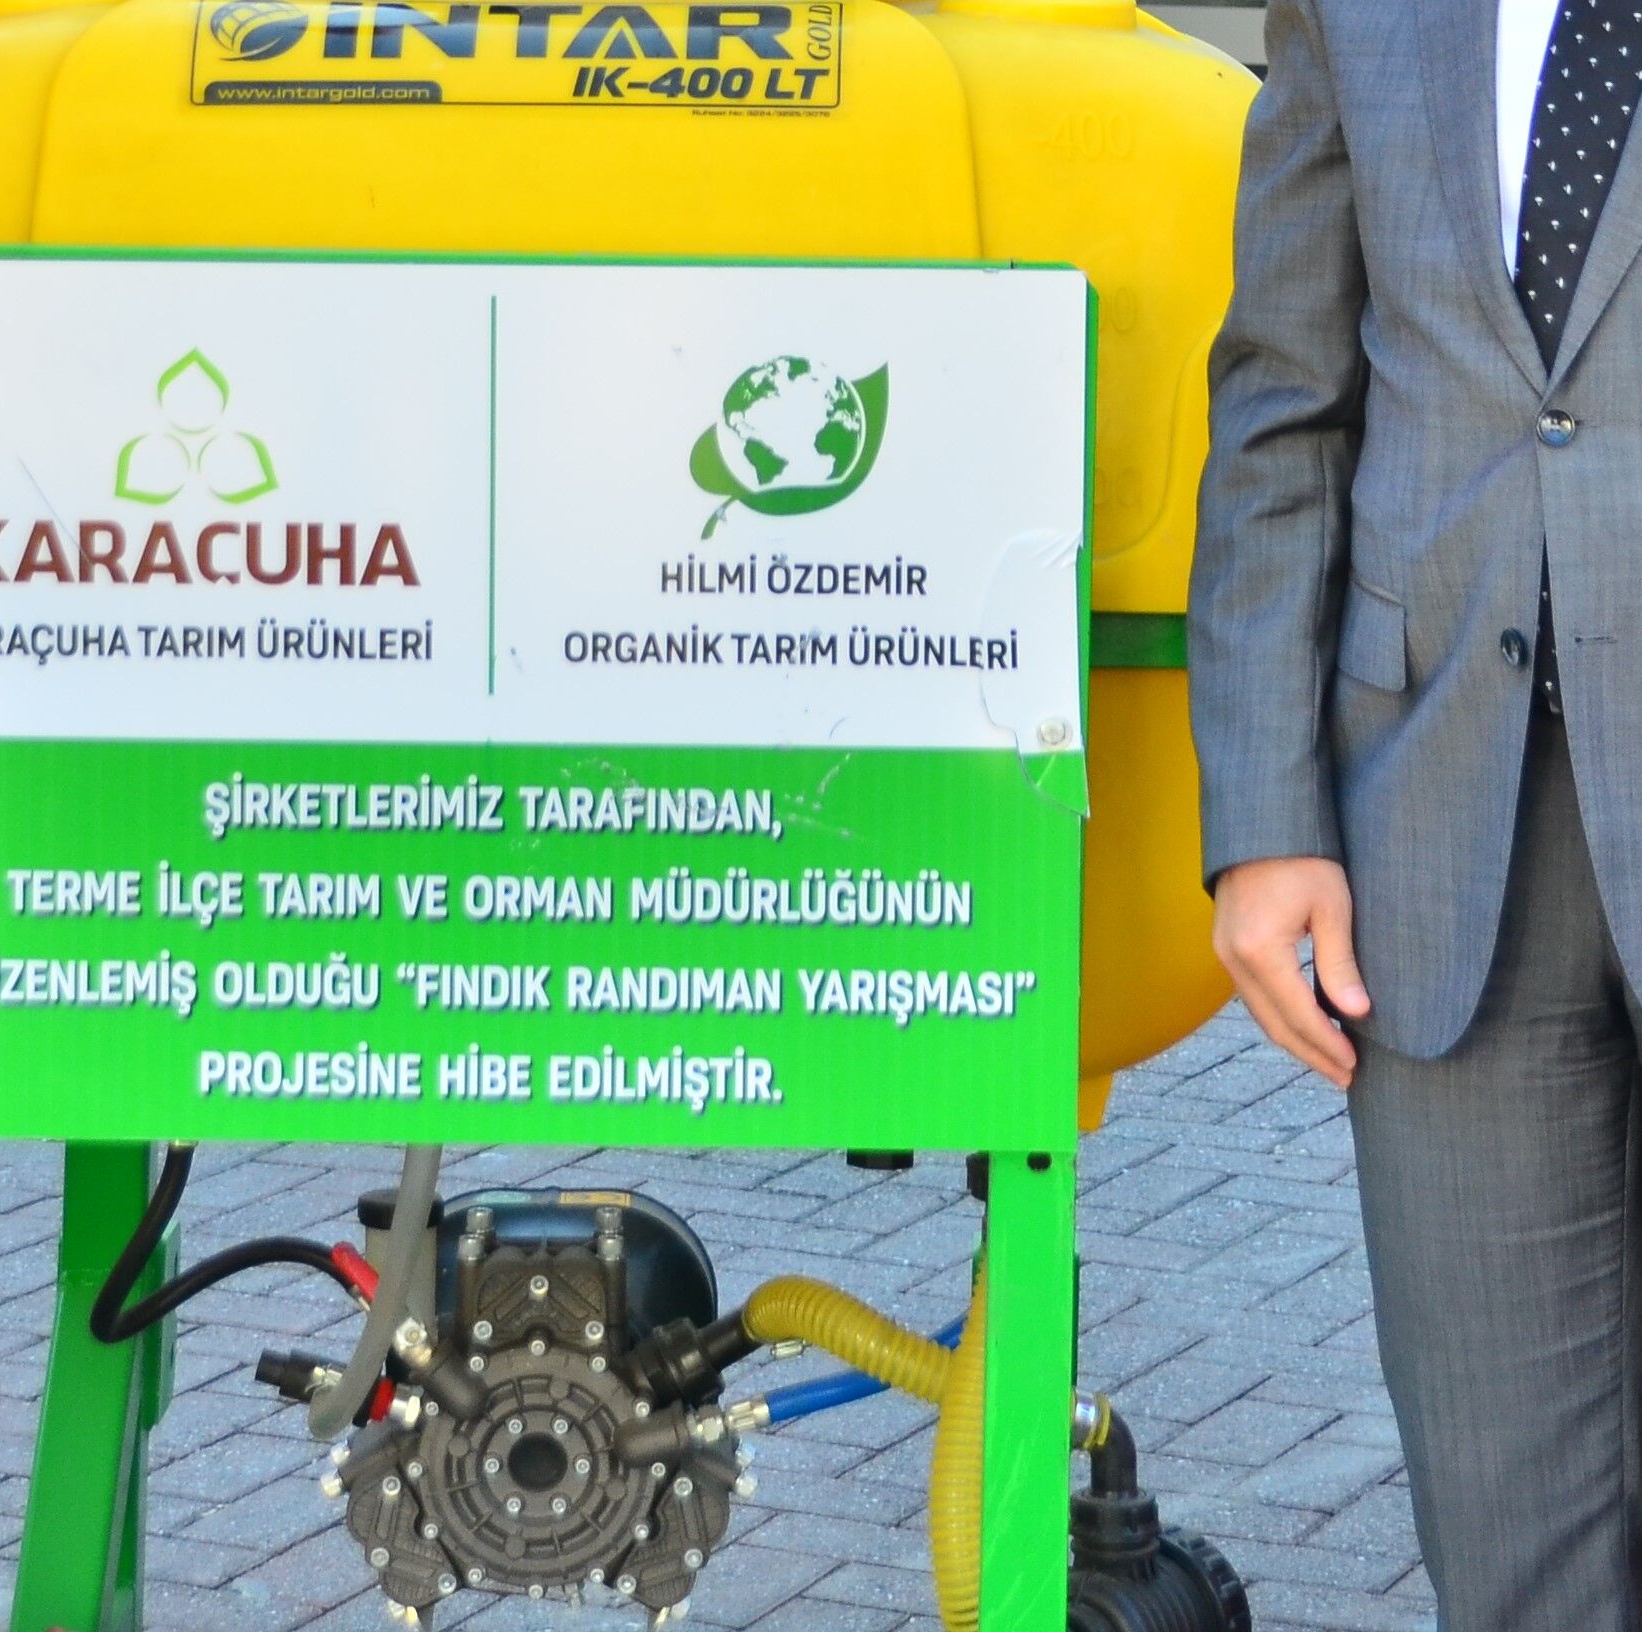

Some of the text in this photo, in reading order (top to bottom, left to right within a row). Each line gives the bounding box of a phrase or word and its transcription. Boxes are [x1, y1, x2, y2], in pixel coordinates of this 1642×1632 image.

[323, 1, 833, 62] INTAR GOLD
[217, 85, 431, 103] www.intargold.com
[572, 66, 830, 100] IK-400 LT
[661, 553, 927, 596] HİLMİ ÖZDEMİR
[138, 625, 245, 658] TARIM
[257, 617, 433, 660] ÜRÜNLERİ
[564, 624, 1018, 669] ORGANİK TARIM ÜRÜNLERİ
[205, 771, 783, 840] ŞİRKETLERİMİZ TARAFINDAN,
[7, 860, 971, 927] TERME İLÇE TARIM VE ORMAN MÜDÜRLÜĞÜNÜN
[214, 952, 380, 1008] OLDUĞU
[567, 966, 782, 1011] RANDIMAN
[200, 1041, 784, 1113] PROJESİNE HİBE EDİLMİŞTİR.
